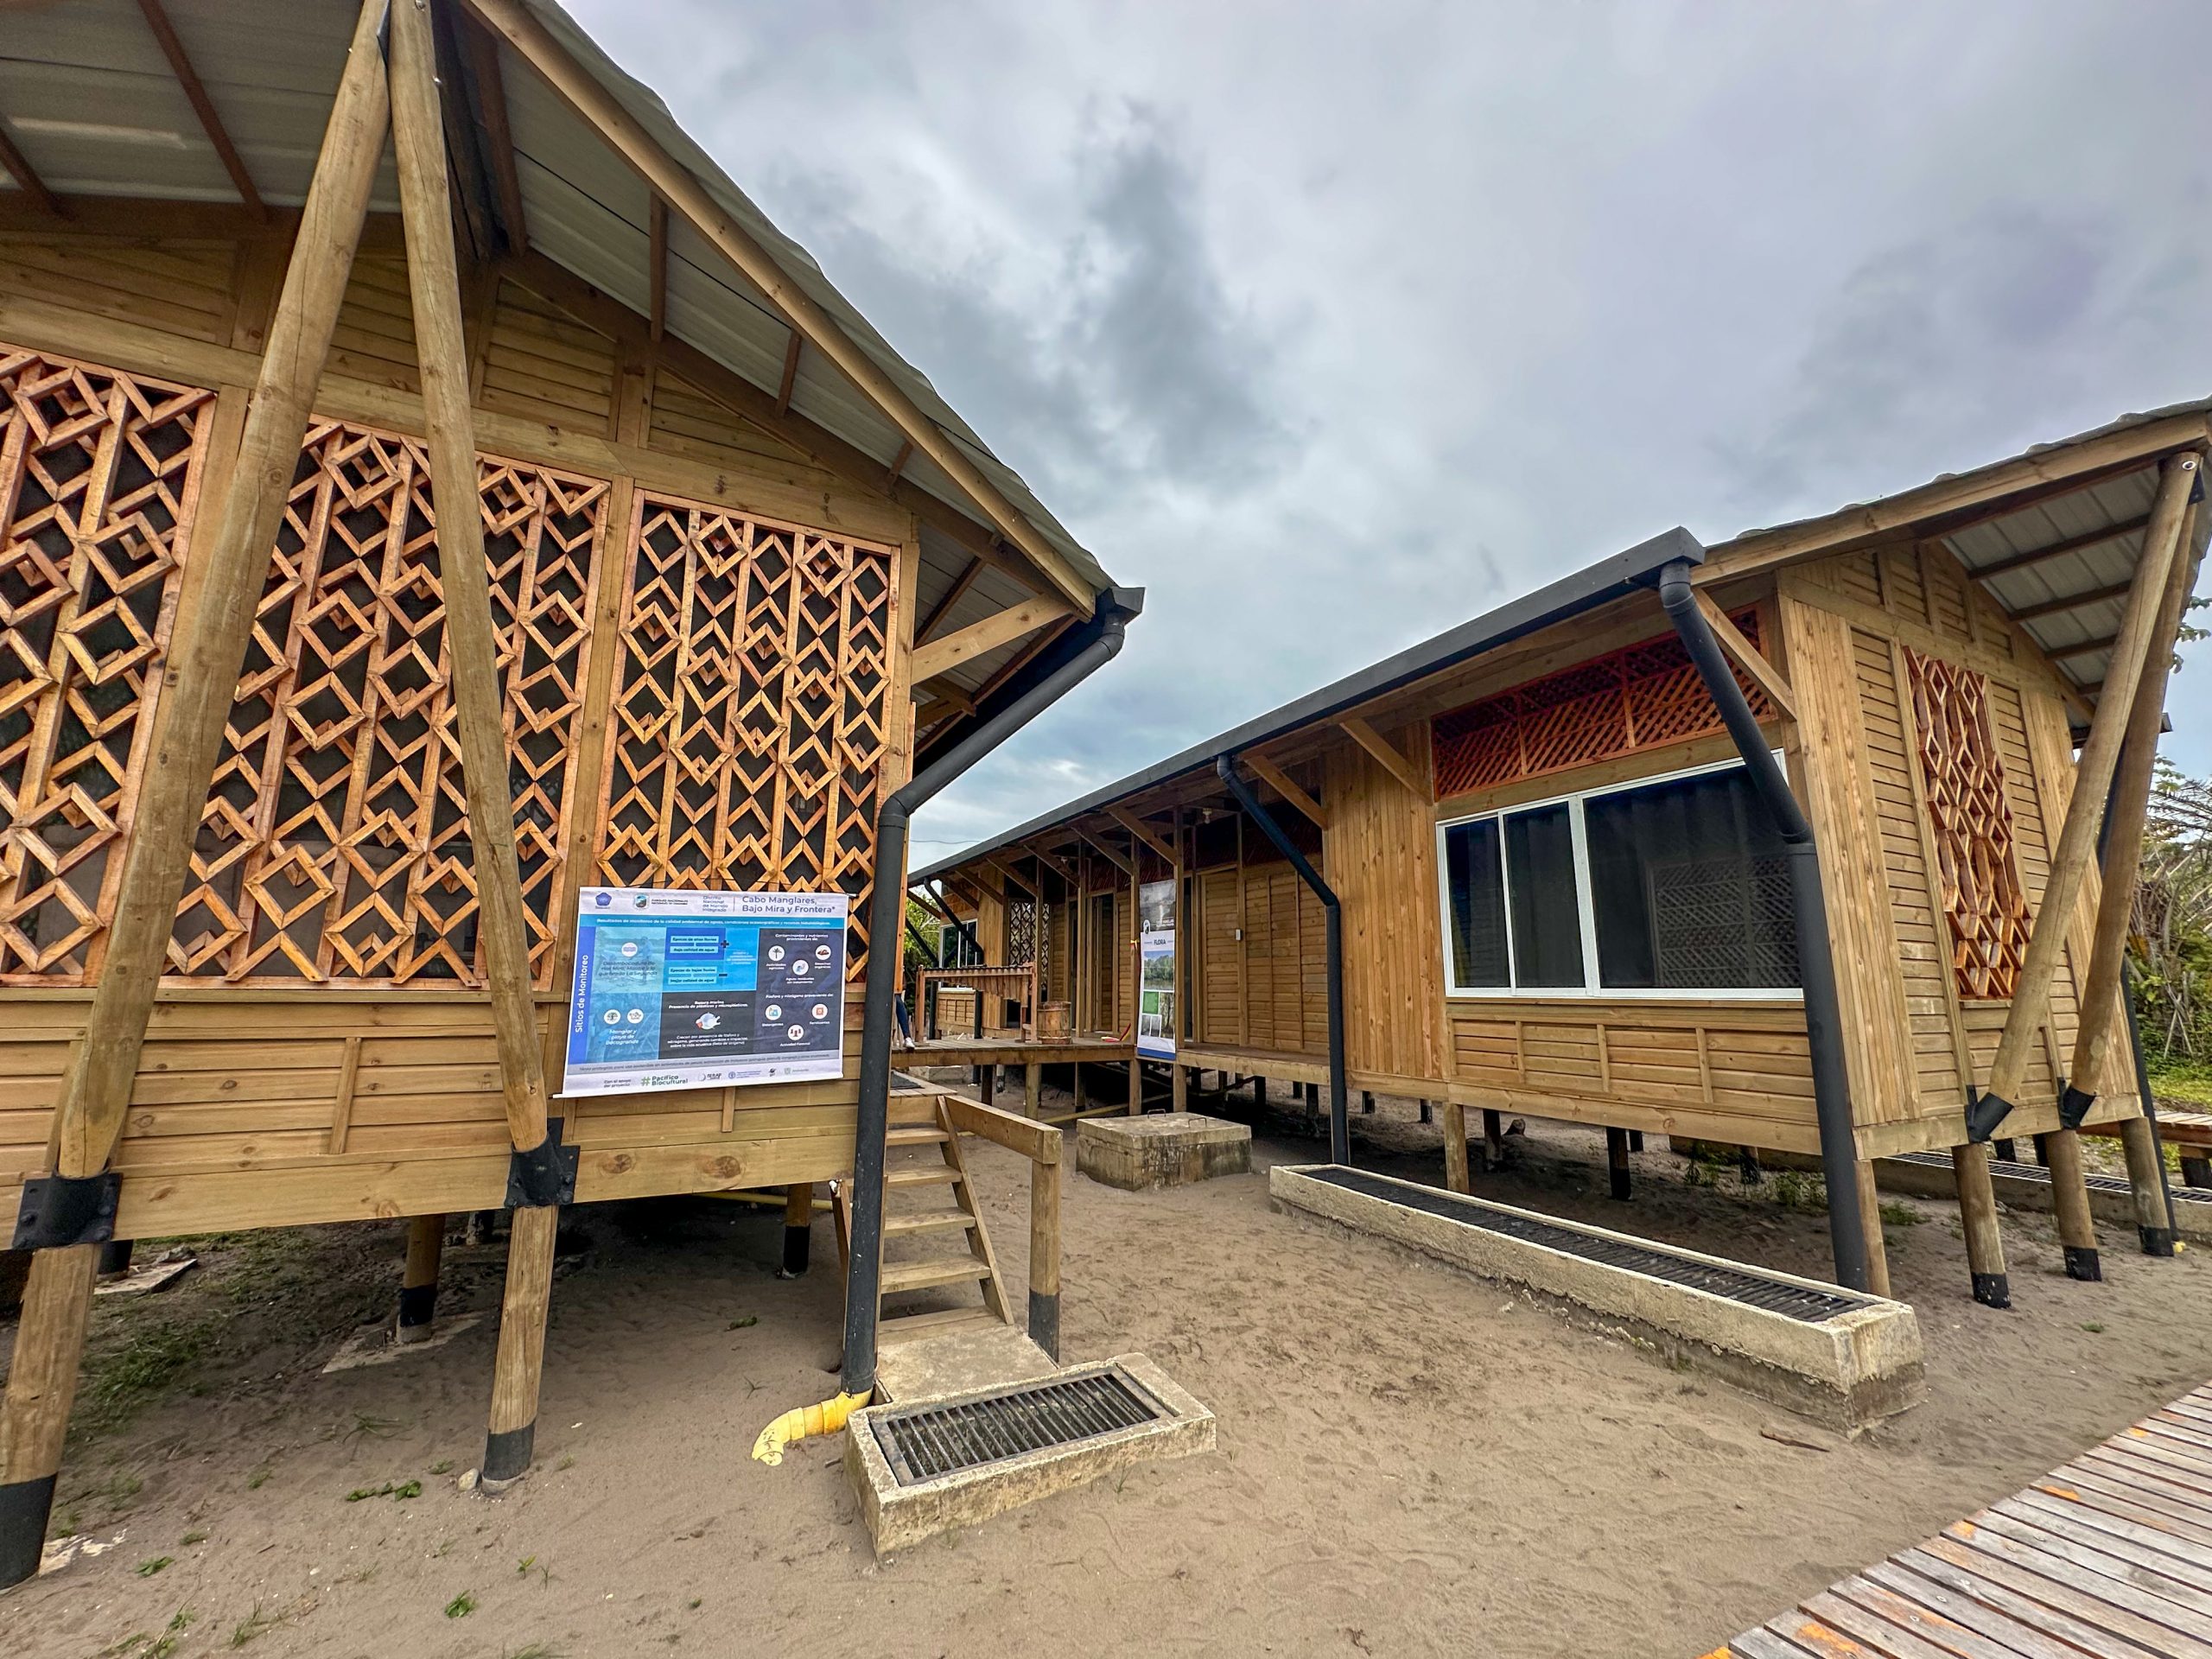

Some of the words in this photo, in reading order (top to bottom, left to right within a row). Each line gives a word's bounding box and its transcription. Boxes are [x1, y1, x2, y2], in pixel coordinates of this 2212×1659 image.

[769, 896, 817, 905] Manglares,
[742, 905, 763, 913] Bajo
[578, 955, 589, 996] Monitoreo
[577, 997, 585, 1008] de
[575, 1010, 584, 1033] Sitios
